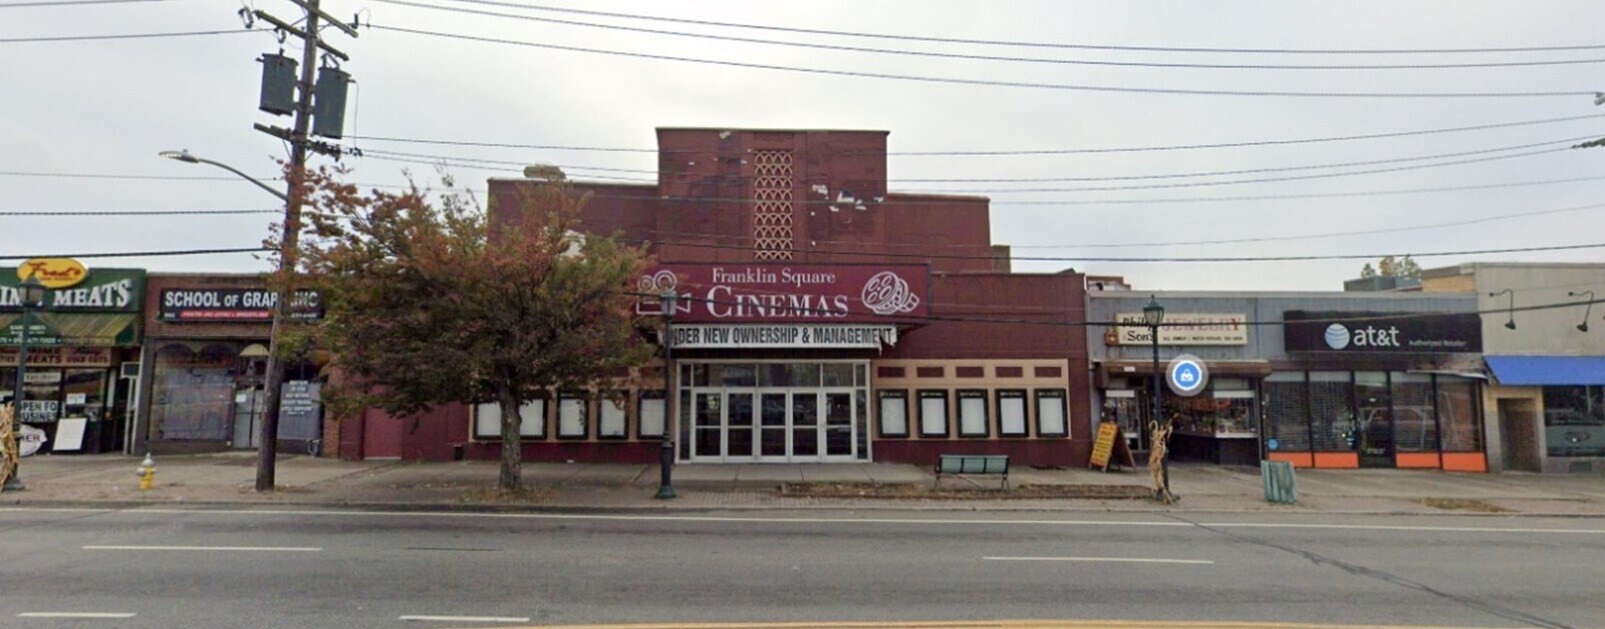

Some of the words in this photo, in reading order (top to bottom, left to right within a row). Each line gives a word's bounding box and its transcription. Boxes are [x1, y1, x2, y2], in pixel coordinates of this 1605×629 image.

[712, 267, 776, 284] Franklin
[781, 267, 836, 287] Square
[53, 279, 132, 307] MEATS
[165, 291, 220, 308] SCHOOL
[224, 294, 239, 308] OF
[706, 285, 848, 318] CINEMAS
[703, 327, 730, 345] NEW
[733, 327, 798, 345] OWNERSHIP
[801, 328, 810, 345] &
[813, 327, 893, 346] MANAGEMENT
[1353, 325, 1401, 347] at&t
[22, 401, 42, 411] PEN
